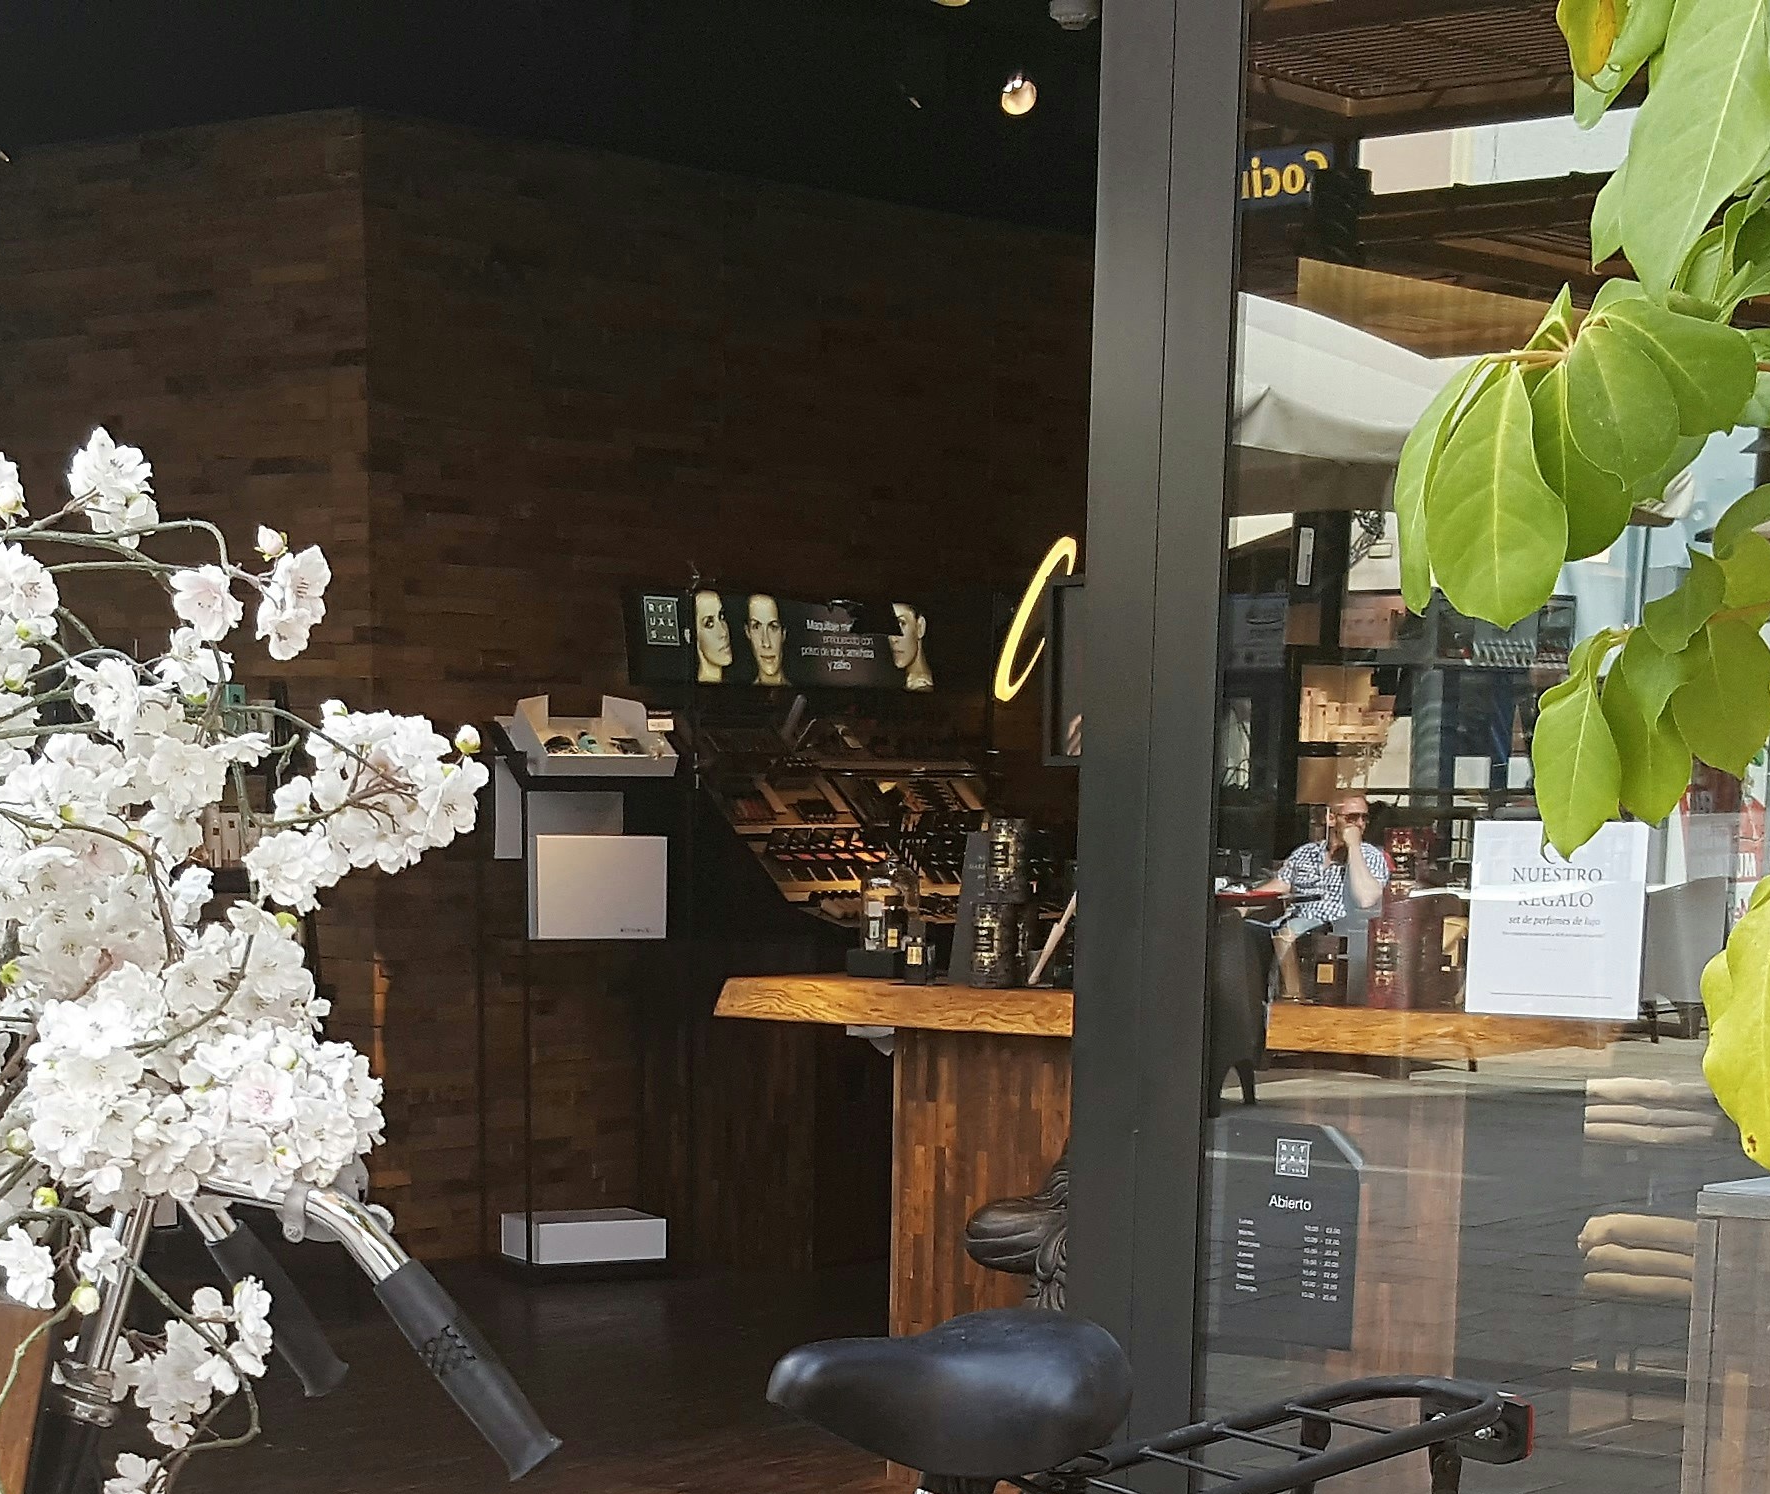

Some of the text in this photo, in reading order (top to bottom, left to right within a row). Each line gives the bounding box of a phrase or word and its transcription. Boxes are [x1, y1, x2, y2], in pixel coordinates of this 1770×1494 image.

[1512, 867, 1602, 883] NUESTRO
[1508, 915, 1520, 925] set
[1522, 915, 1532, 925] de
[1533, 915, 1571, 926] perfumes
[1572, 916, 1583, 926] de
[1268, 1194, 1312, 1211] Abierto
